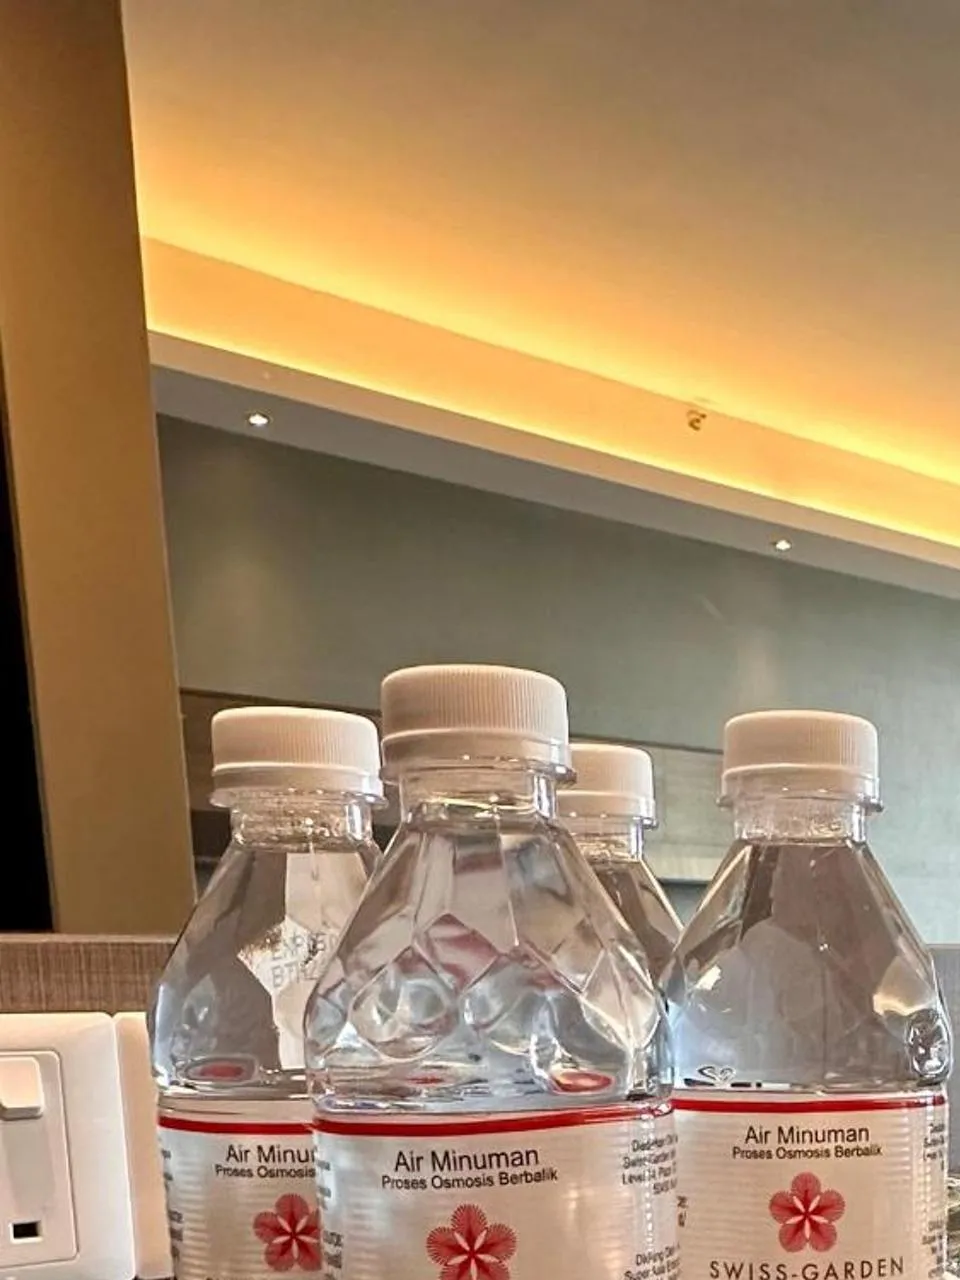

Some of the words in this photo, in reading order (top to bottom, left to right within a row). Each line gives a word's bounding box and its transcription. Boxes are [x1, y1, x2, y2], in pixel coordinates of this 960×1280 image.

[745, 1125, 772, 1144] Air
[777, 1125, 870, 1144] Minuman
[225, 1144, 250, 1165] Air
[394, 1151, 424, 1173] Air
[431, 1148, 539, 1172] Minuman
[732, 1146, 773, 1160] Proses
[776, 1146, 831, 1160] Osmosis
[834, 1143, 882, 1158] Berbalik
[215, 1165, 254, 1178] Proses
[256, 1165, 316, 1179] Osmosis
[381, 1175, 428, 1190] Proses
[432, 1172, 495, 1190] Osmosis
[499, 1166, 558, 1186] Berbalik
